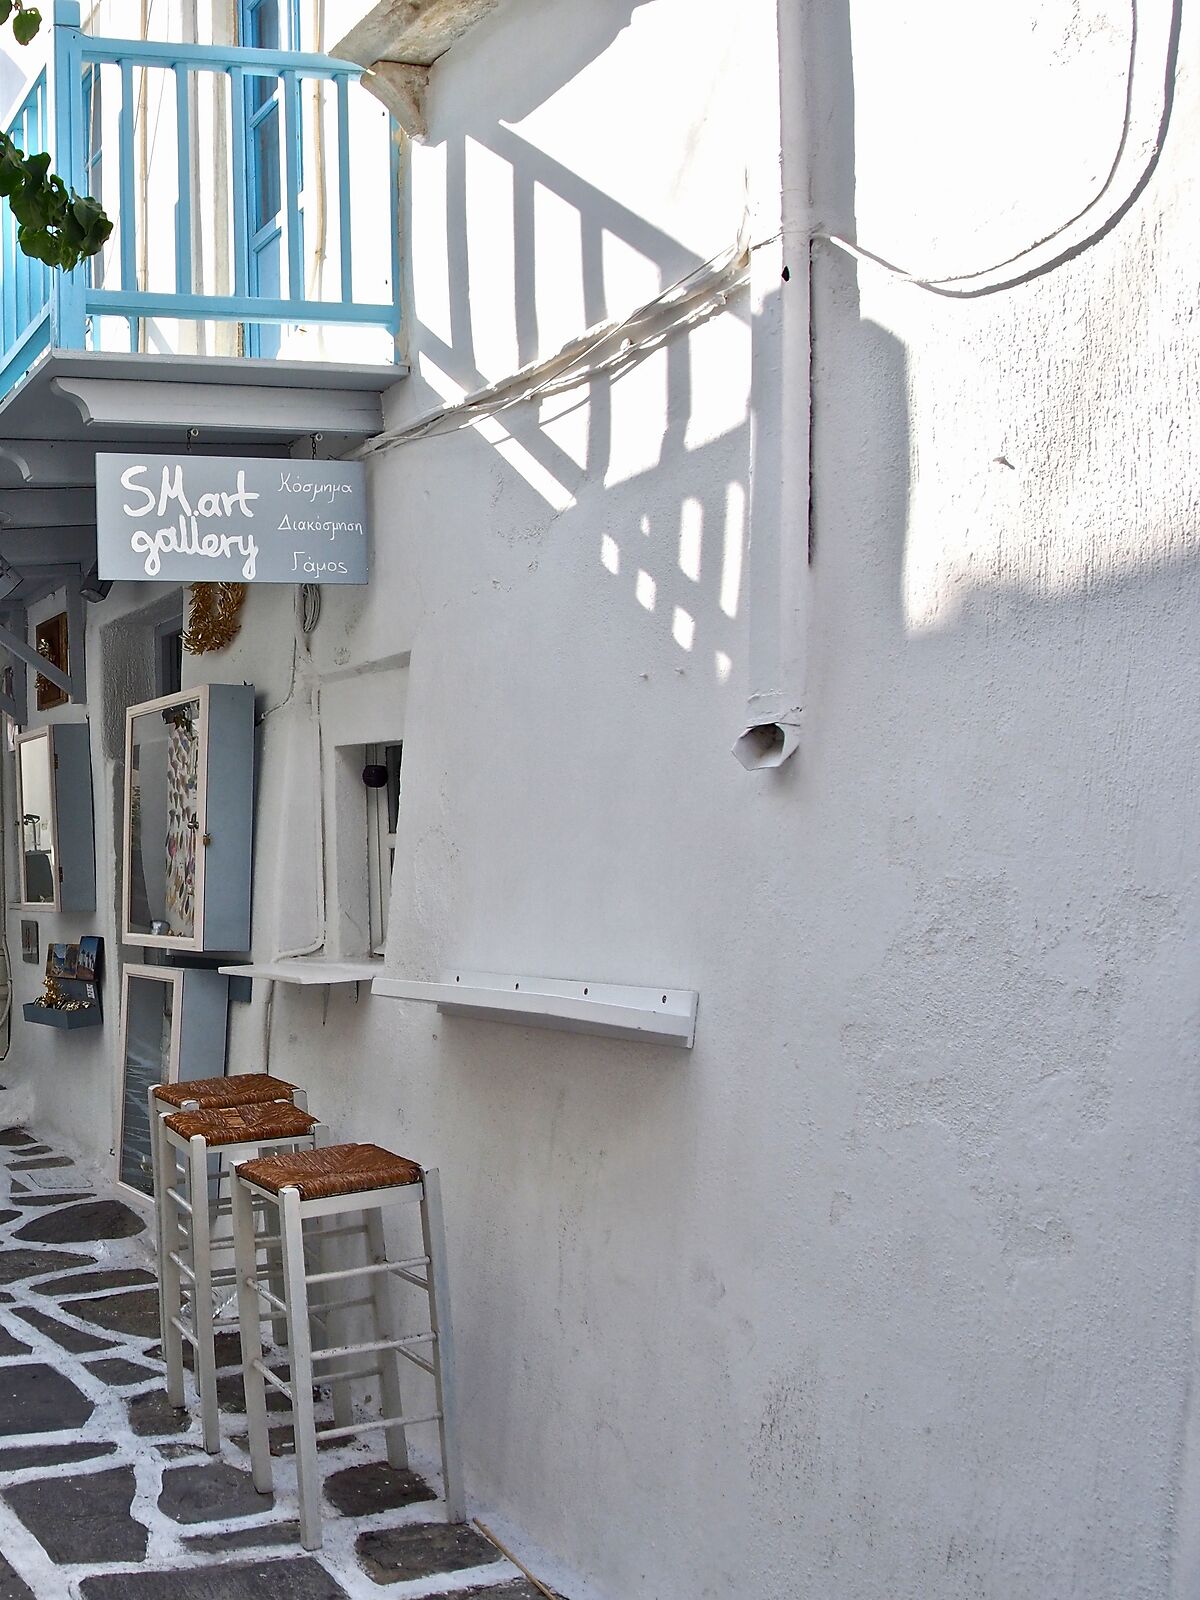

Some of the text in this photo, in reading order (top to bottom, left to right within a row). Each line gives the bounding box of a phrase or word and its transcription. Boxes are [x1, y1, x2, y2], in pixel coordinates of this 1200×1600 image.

[277, 472, 353, 503] Κόσμημα
[277, 514, 364, 541] Διακόσμηση
[130, 514, 259, 581] gallery
[291, 551, 348, 579] Γάμος
